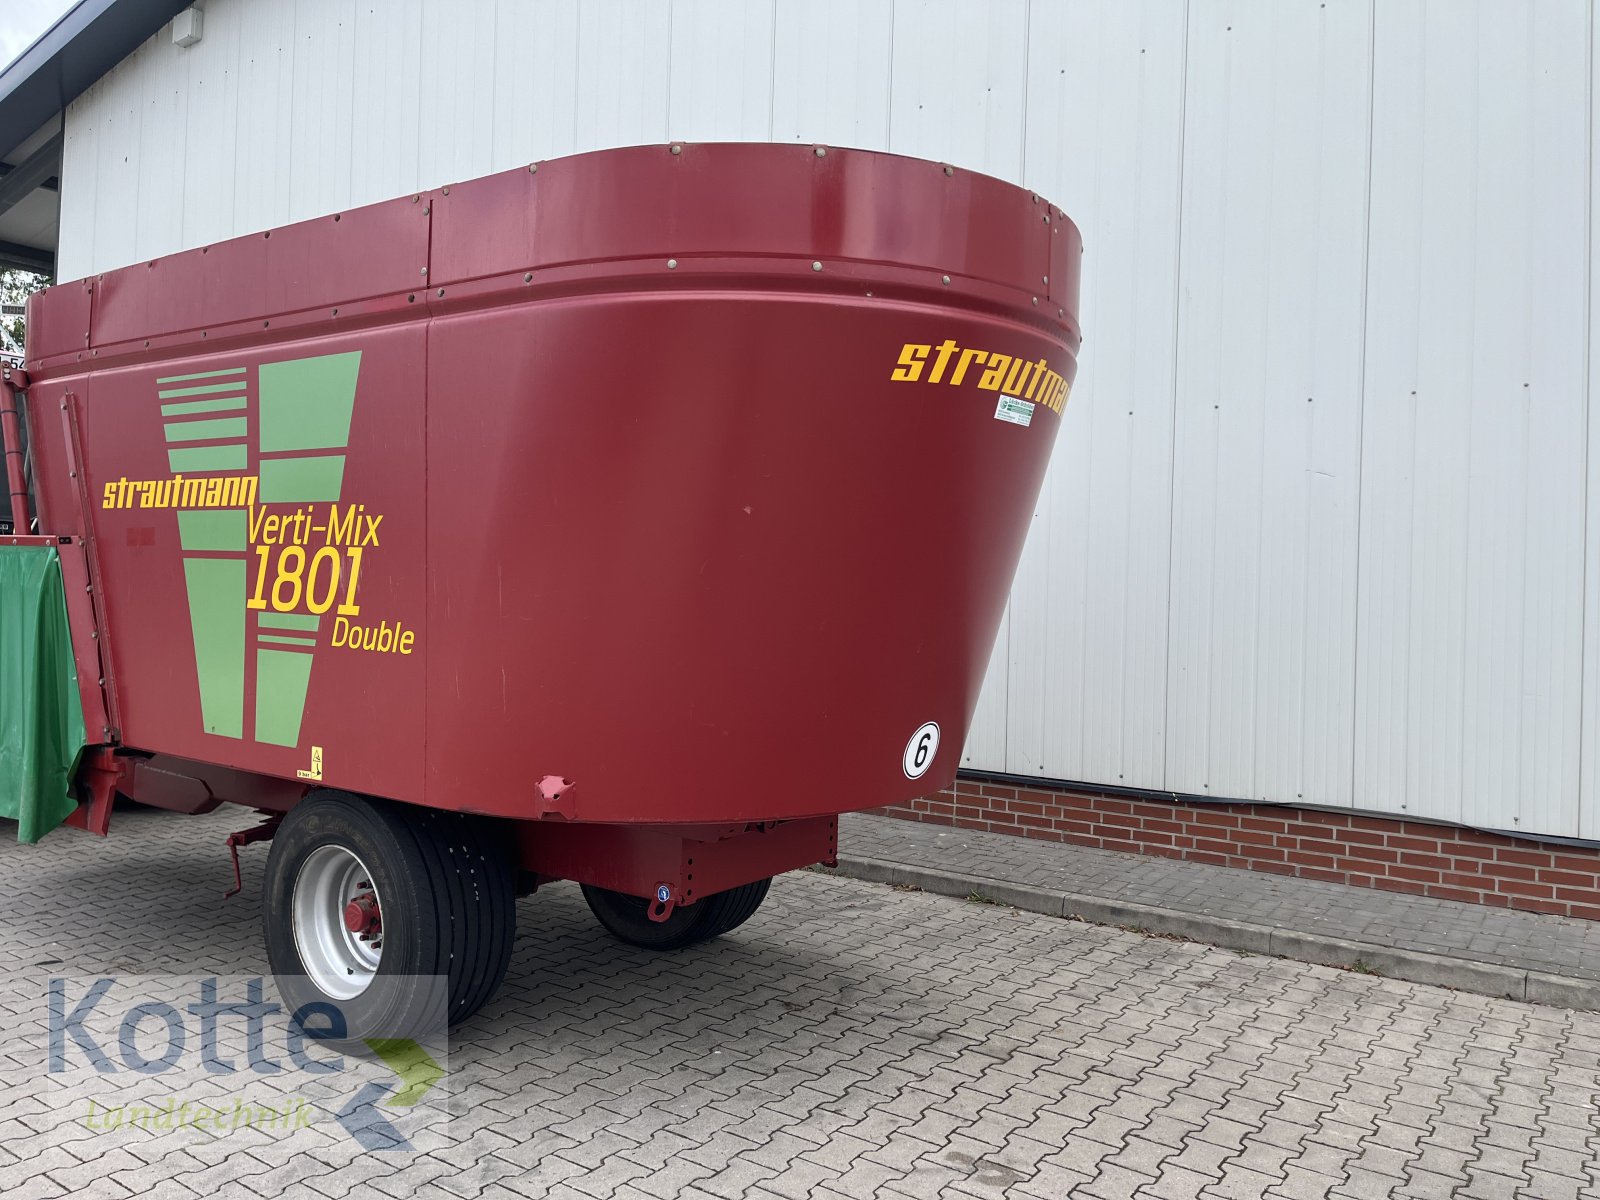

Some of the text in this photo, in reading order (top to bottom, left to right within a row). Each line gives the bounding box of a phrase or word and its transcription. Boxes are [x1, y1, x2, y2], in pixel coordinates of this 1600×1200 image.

[102, 475, 258, 509] strautmann
[249, 504, 383, 547] Verti-Mix
[247, 545, 363, 617] 1801
[331, 617, 415, 655] Double
[914, 732, 931, 768] 6
